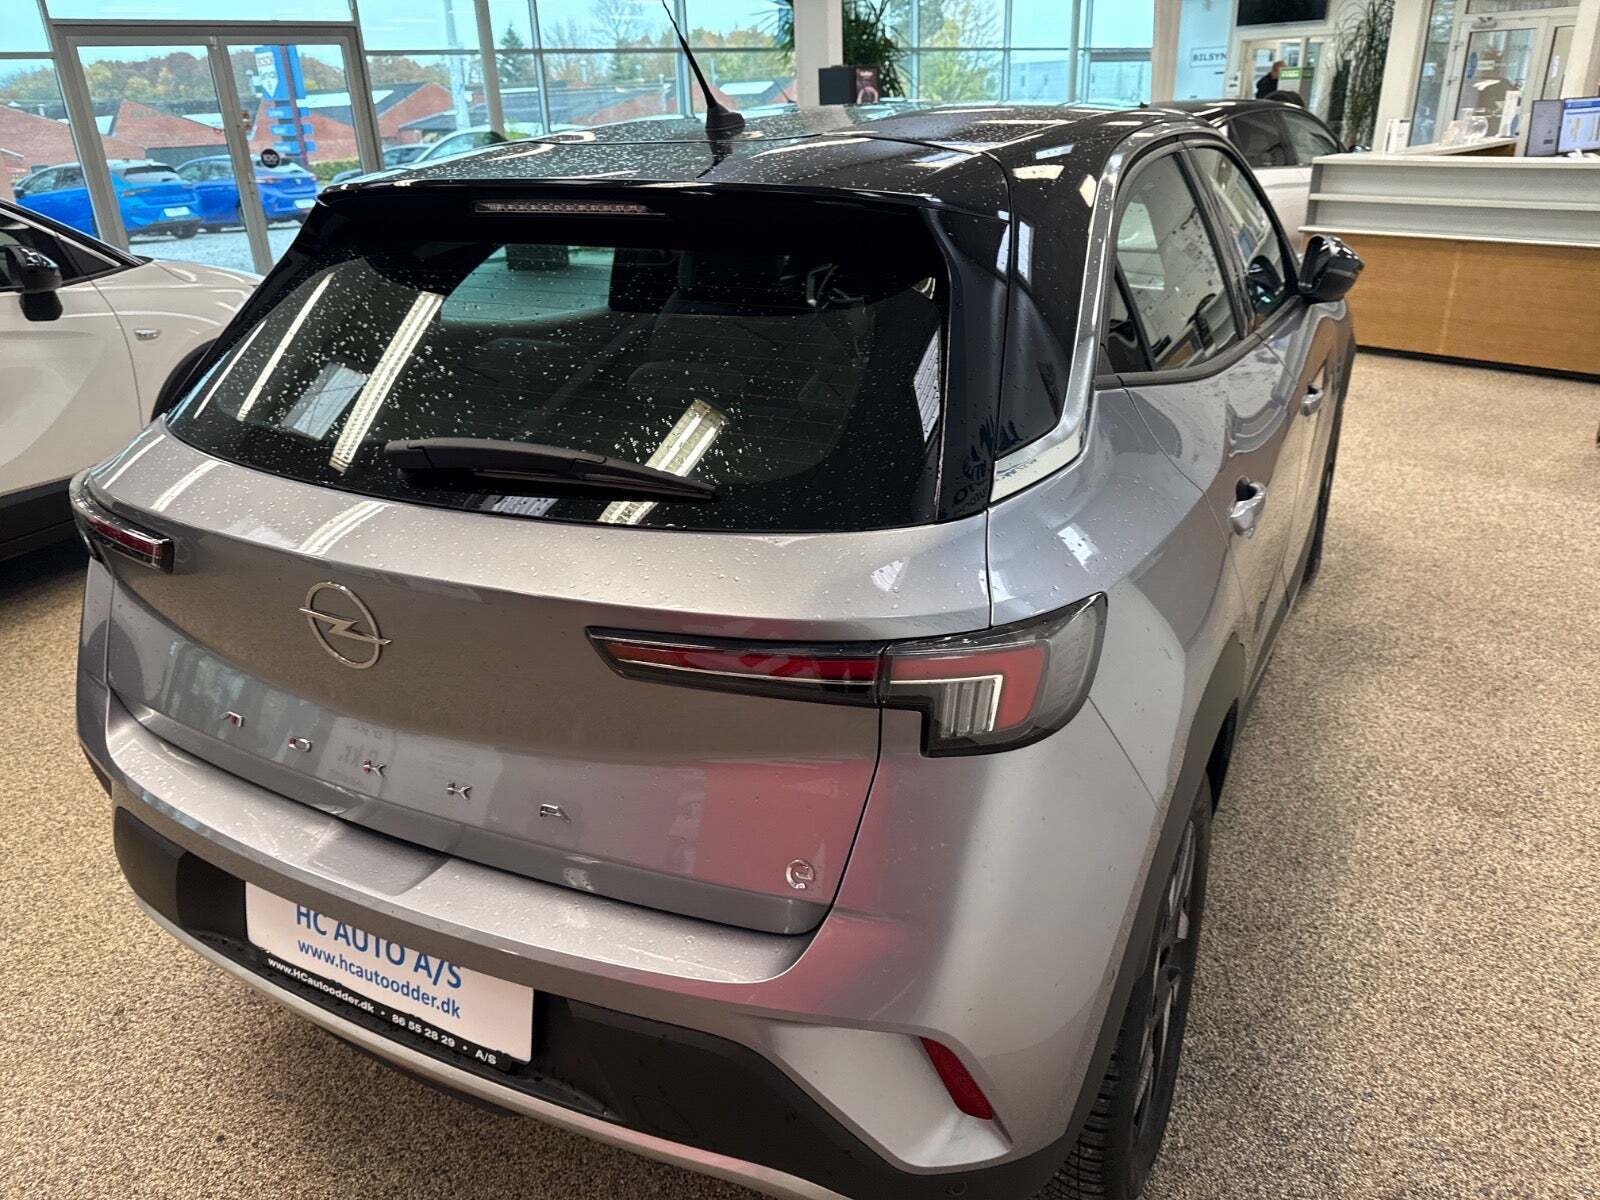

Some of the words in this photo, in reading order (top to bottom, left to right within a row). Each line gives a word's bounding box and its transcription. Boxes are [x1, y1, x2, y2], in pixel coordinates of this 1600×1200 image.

[296, 904, 327, 936] HC
[334, 920, 406, 966] AUTO
[413, 951, 462, 989] A/S
[298, 939, 461, 1019] www.hcautoodder.dk
[267, 957, 375, 1014] www.HCautoodder.dk
[392, 1013, 405, 1027] 86
[408, 1021, 423, 1034] 55
[424, 1027, 438, 1041] 28
[441, 1034, 456, 1048] 29
[475, 1049, 497, 1065] A/S
